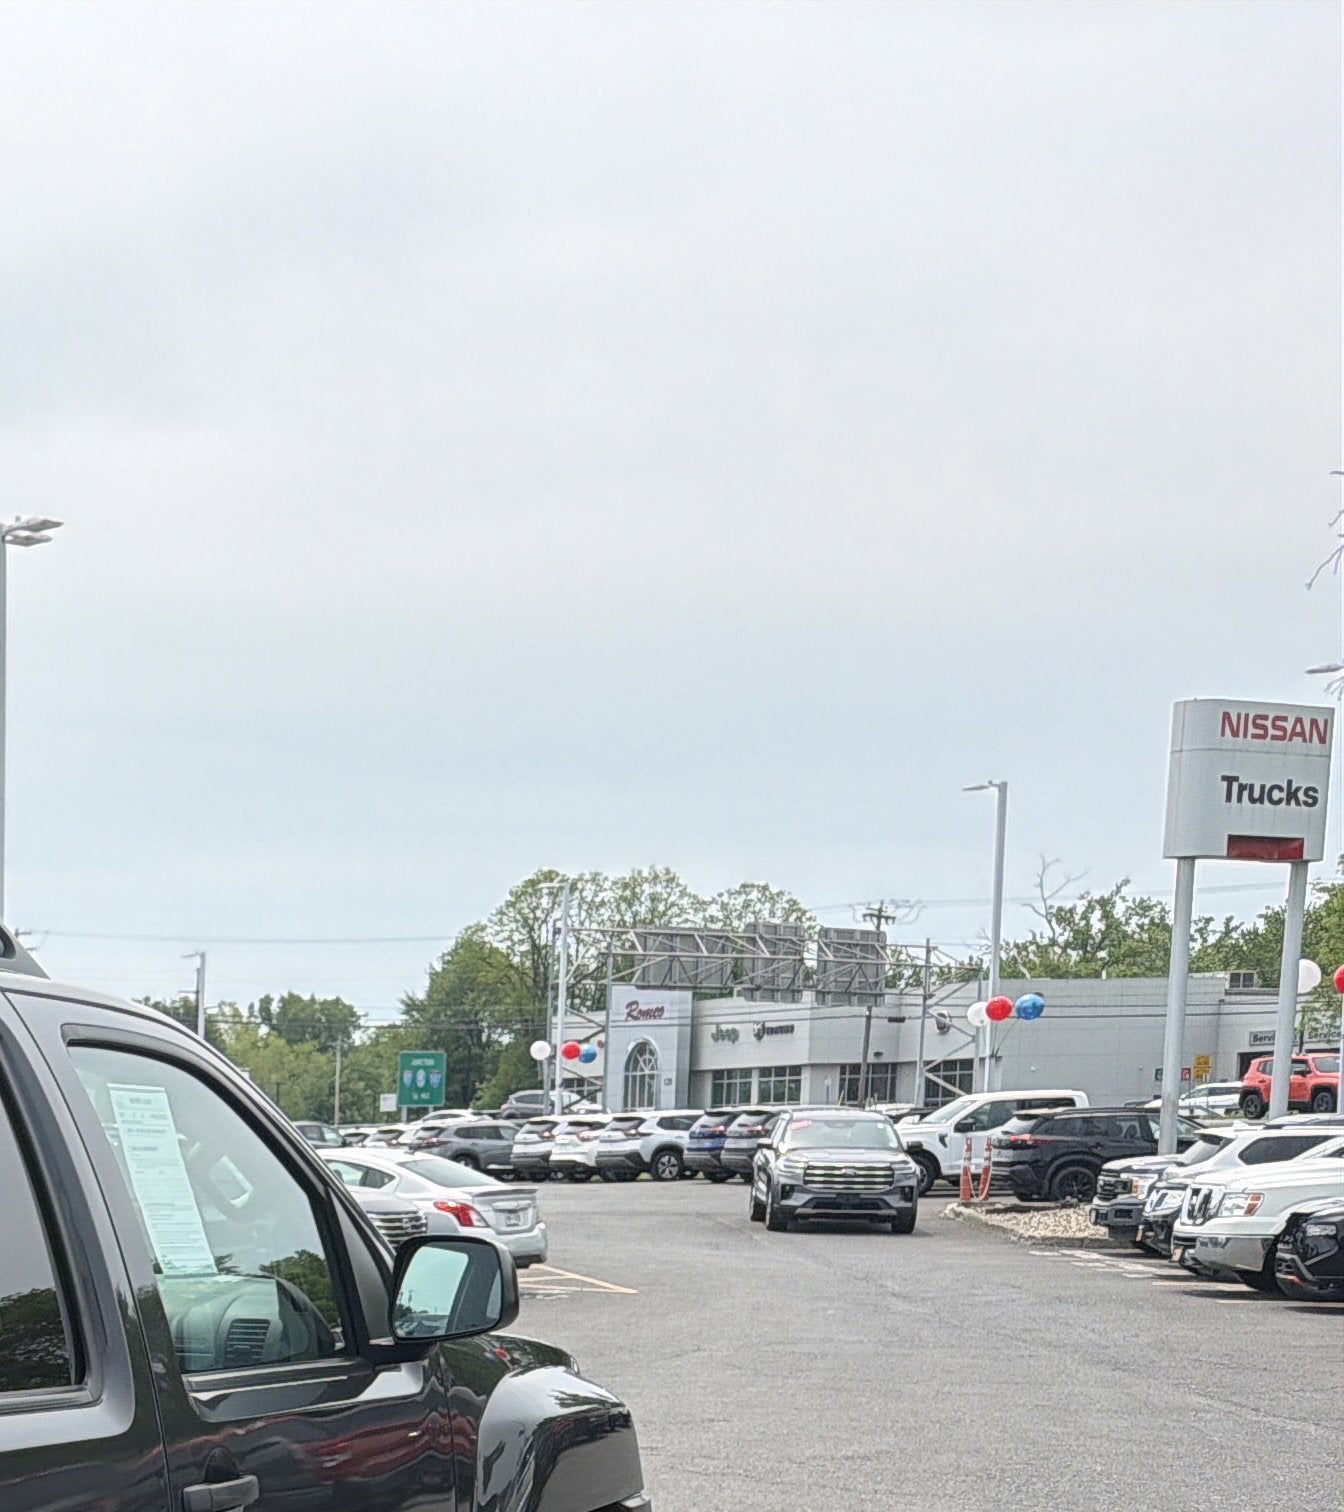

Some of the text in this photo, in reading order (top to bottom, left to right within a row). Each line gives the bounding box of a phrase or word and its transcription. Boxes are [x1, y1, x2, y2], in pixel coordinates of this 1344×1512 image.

[1220, 711, 1329, 745] NISSAN
[1220, 774, 1320, 808] Trucks
[624, 1000, 665, 1022] Romeo
[1252, 1033, 1276, 1043] Servi
